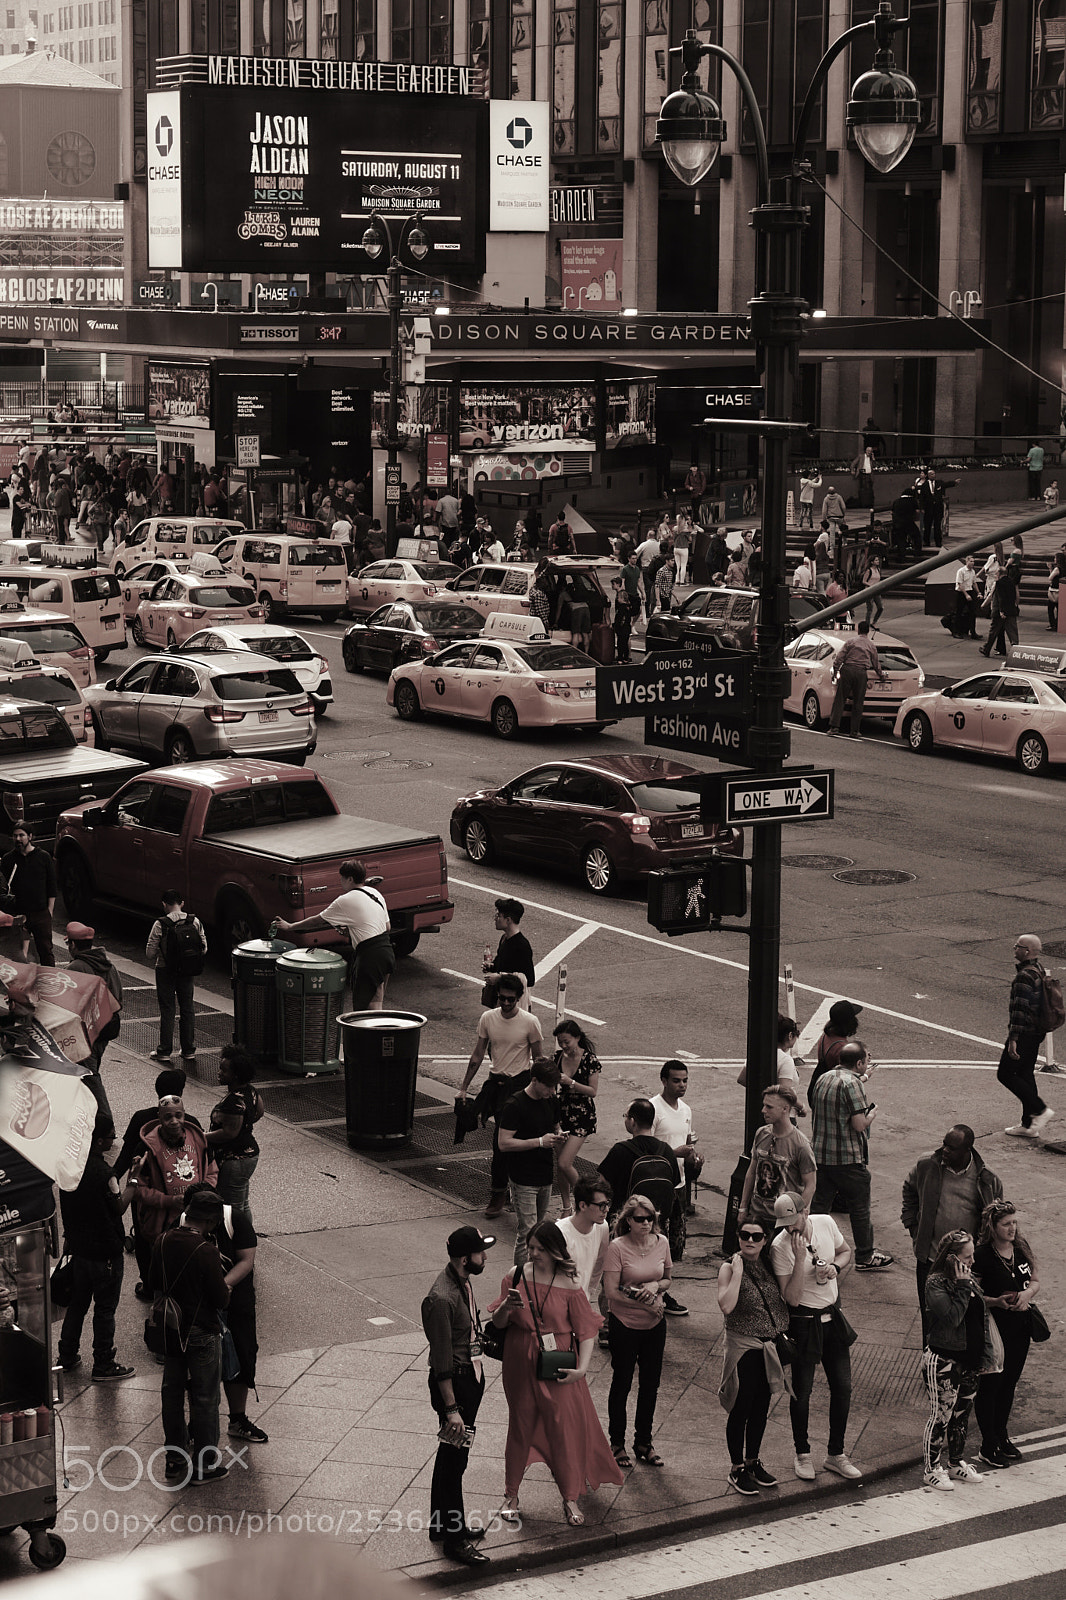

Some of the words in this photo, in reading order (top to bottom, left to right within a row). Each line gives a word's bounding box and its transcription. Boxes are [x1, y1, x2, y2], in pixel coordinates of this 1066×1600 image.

[208, 55, 299, 88] MADISON
[311, 60, 385, 92] SQUARE
[396, 63, 469, 95] GARDEN
[250, 112, 309, 145] JASON
[250, 144, 309, 175] ALDEAN
[496, 155, 542, 167] CHASE
[148, 165, 180, 181] CHASE
[342, 161, 401, 180] SATURDAY,
[404, 163, 448, 179] AUGUST
[450, 164, 460, 180] 11
[254, 176, 277, 190] HIGH
[278, 176, 304, 190] NOON
[254, 189, 304, 201] NEON
[361, 196, 390, 208] MADISON
[391, 197, 415, 209] SQUARE
[416, 198, 441, 209] GARDEN
[552, 189, 595, 222] GARDEN
[244, 210, 281, 224] LUKE
[290, 217, 321, 227] LAUREN
[238, 222, 287, 241] COMBS
[291, 227, 320, 236] ALAINA
[139, 286, 164, 299] CHASE
[0, 315, 29, 330] PENN
[34, 316, 79, 333] STATION
[95, 322, 119, 330] AMTRAK
[257, 329, 298, 338] TISSOT
[320, 326, 342, 340] 3:47
[534, 324, 638, 341] SQUARE
[651, 325, 750, 340] GARDEN
[163, 396, 197, 416] verizon
[705, 394, 752, 406] CHASE
[397, 419, 432, 438] erizon
[493, 421, 564, 440] verizon
[239, 438, 258, 446] STOP
[499, 620, 527, 632] CAPSULE
[684, 640, 695, 650] 401
[700, 643, 712, 653] 419
[655, 661, 670, 671] 100
[679, 659, 693, 669] 162
[612, 679, 666, 705] West
[671, 672, 708, 701] 33rd
[714, 673, 735, 698] St
[653, 713, 707, 742] Fashion
[711, 721, 740, 748] Ave
[742, 791, 771, 809] ONE
[784, 787, 813, 805] WAY
